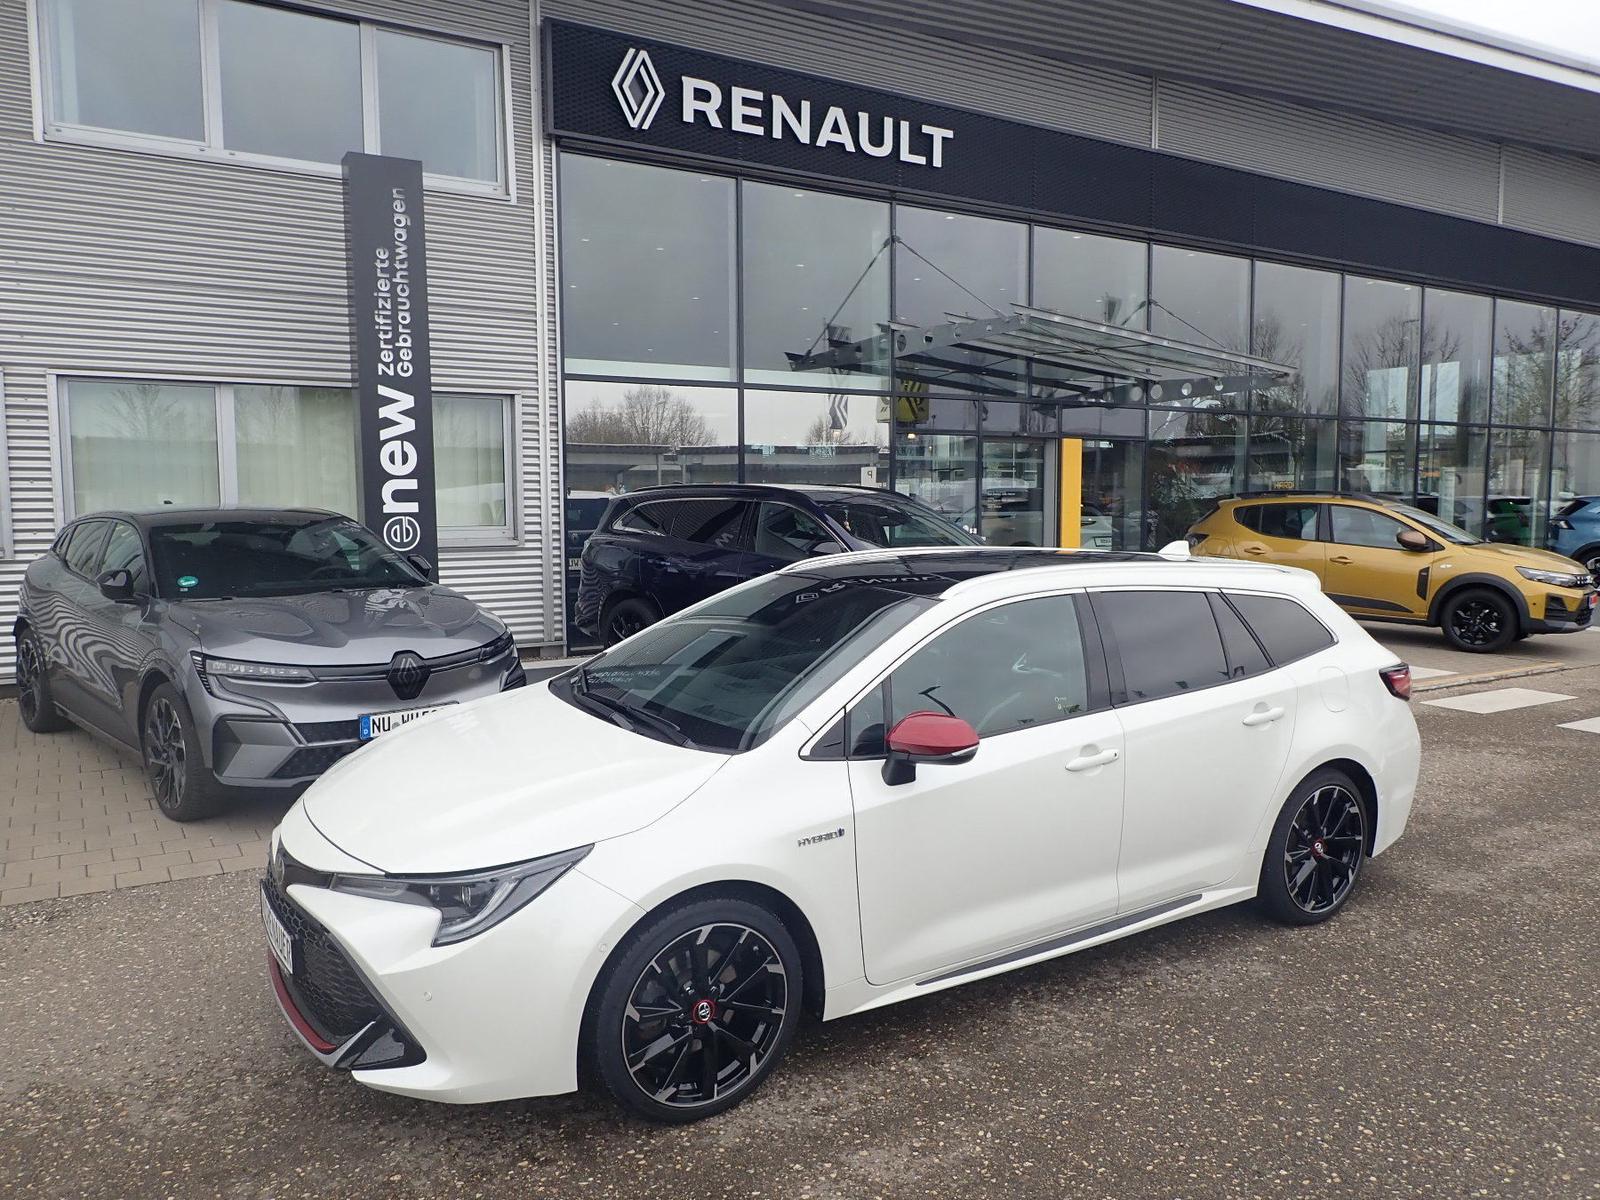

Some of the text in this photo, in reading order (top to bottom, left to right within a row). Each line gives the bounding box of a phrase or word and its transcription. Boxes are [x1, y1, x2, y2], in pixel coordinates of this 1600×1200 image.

[681, 75, 954, 168] RENAULT
[374, 247, 395, 376] Zertifizierte
[392, 188, 414, 378] Gebrauchtwagen
[371, 716, 391, 734] NU
[797, 831, 839, 847] HYBRID
